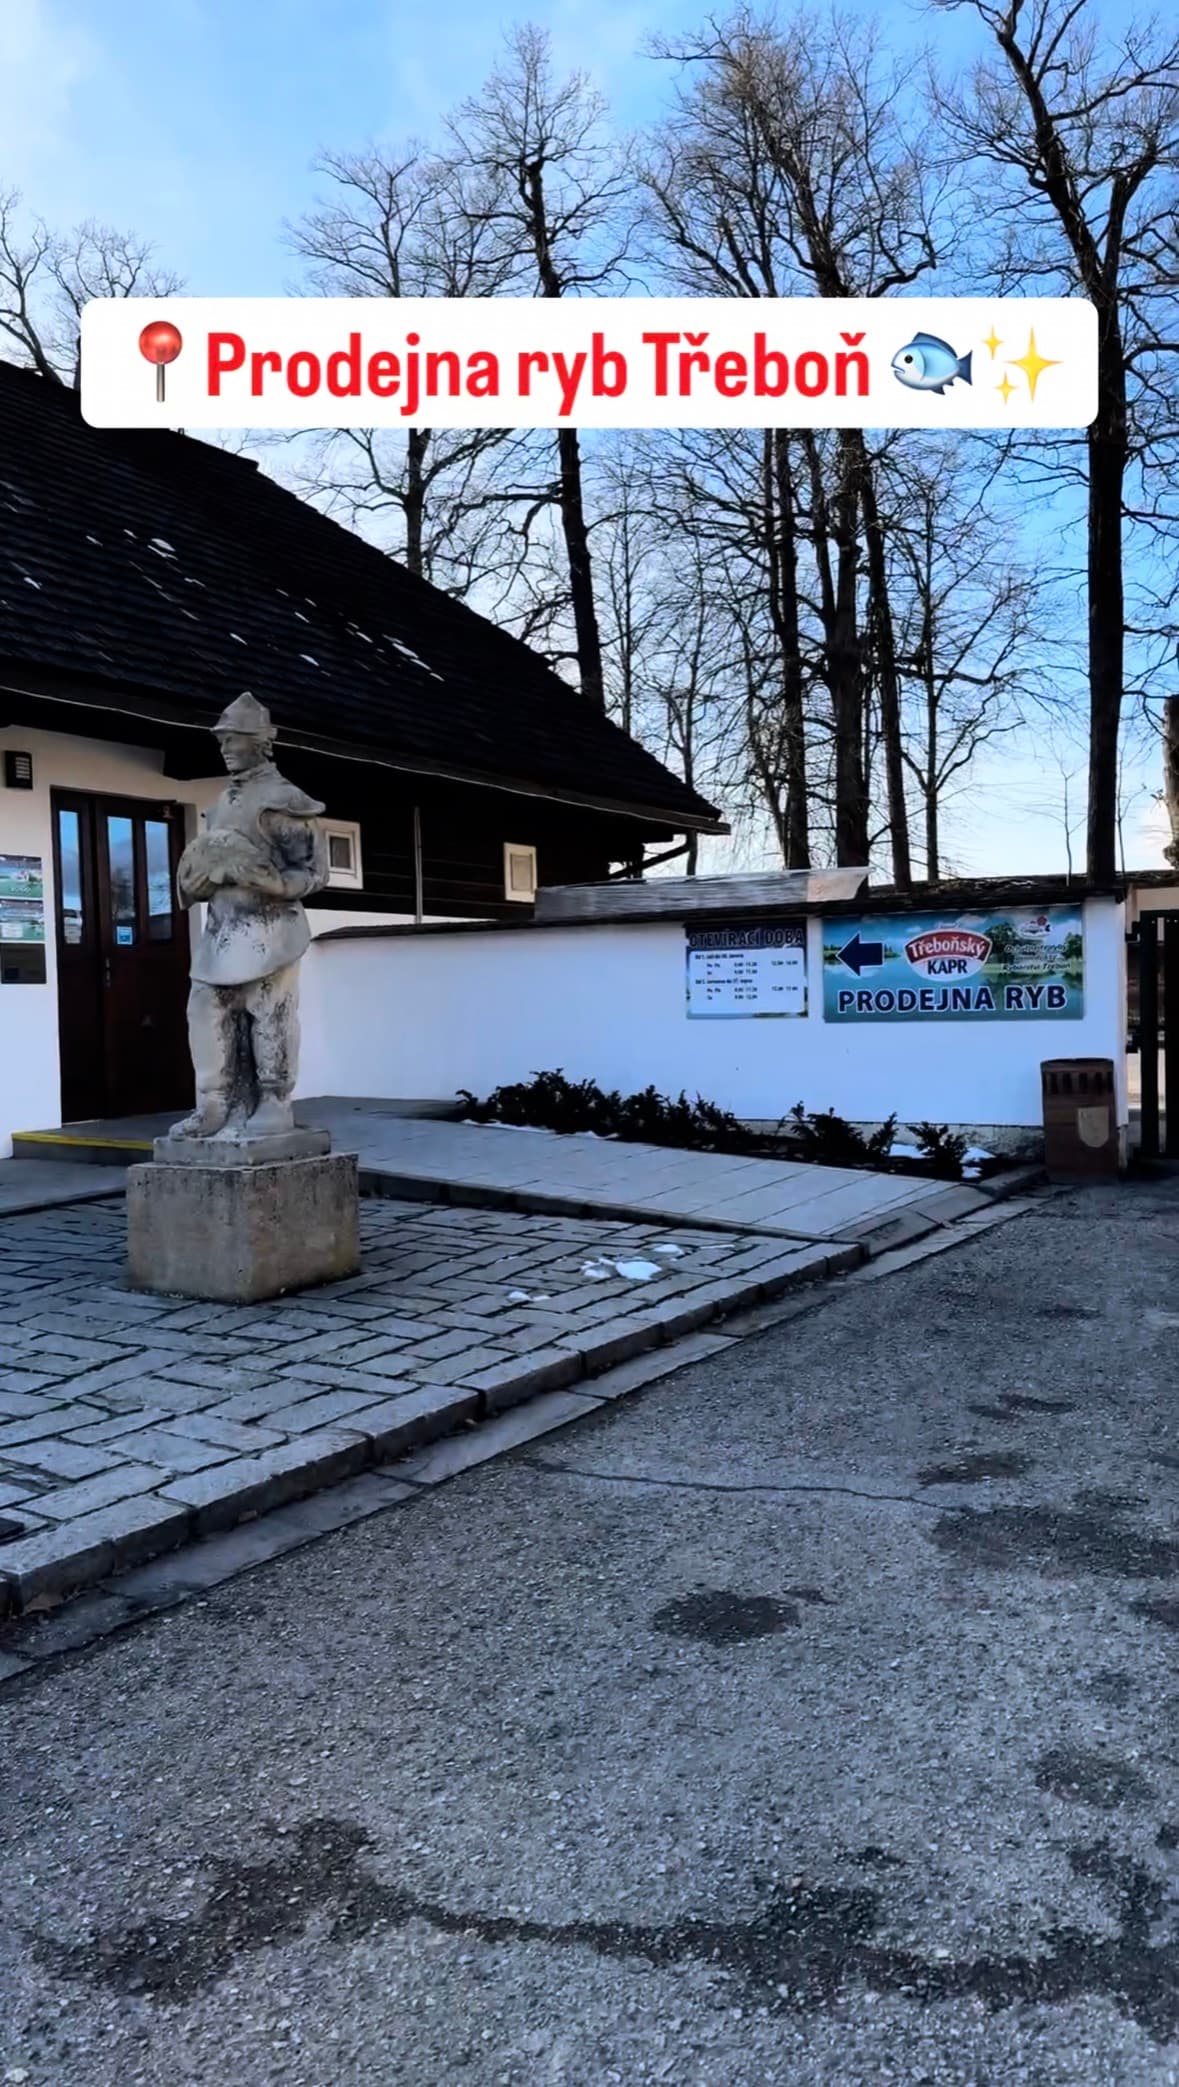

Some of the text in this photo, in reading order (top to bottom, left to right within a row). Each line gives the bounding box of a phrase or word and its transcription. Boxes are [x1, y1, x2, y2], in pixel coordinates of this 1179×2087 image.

[908, 936, 985, 958] Třeboňský
[928, 960, 968, 975] KAPR
[837, 984, 1067, 1014] PRODEJNA RYB
